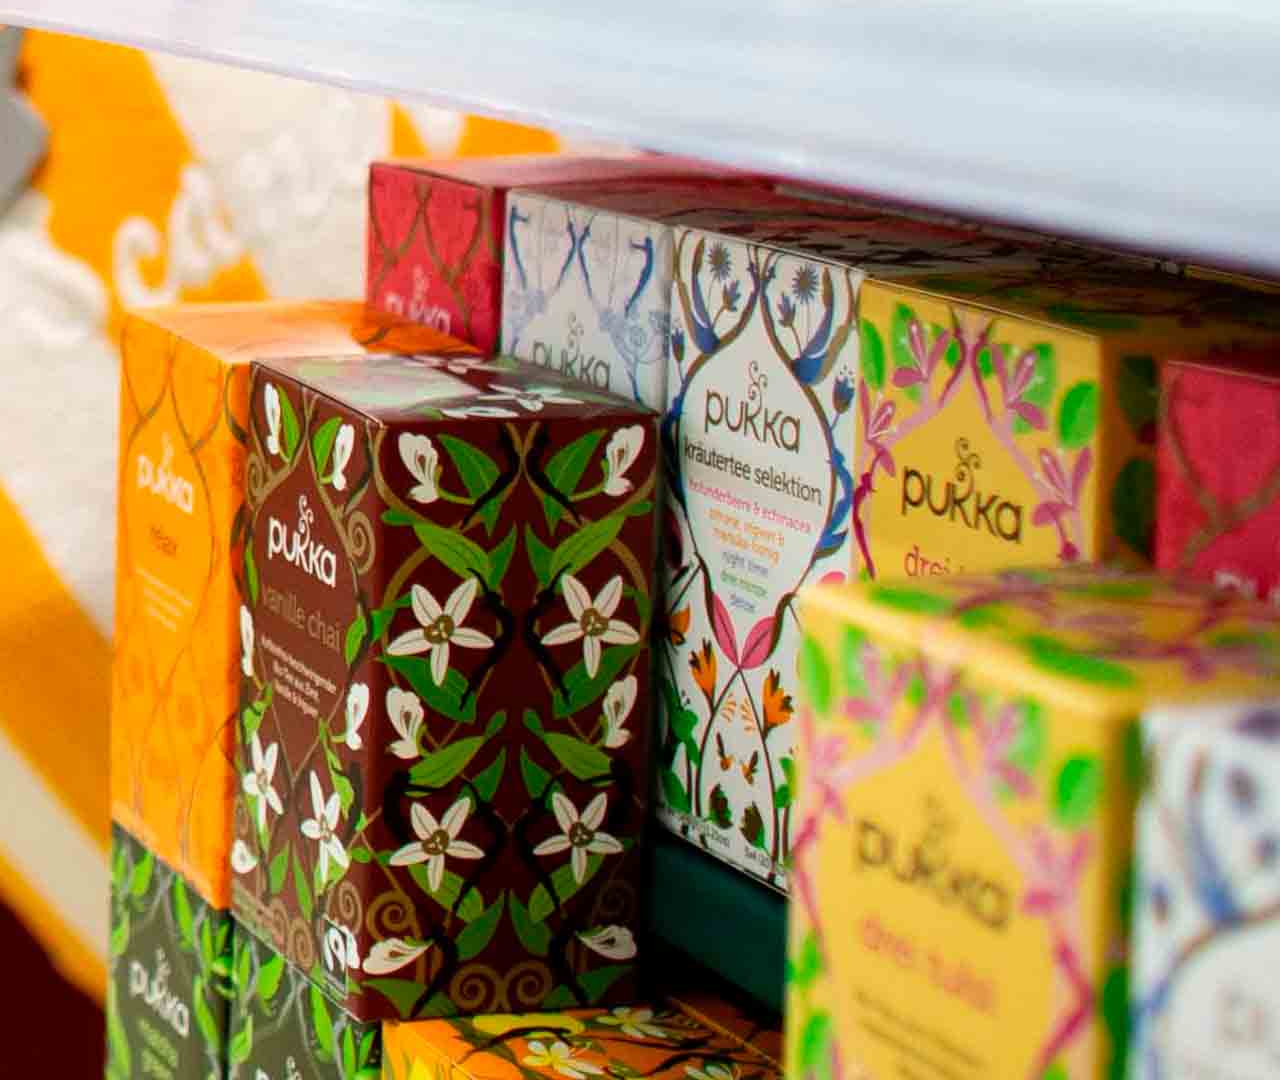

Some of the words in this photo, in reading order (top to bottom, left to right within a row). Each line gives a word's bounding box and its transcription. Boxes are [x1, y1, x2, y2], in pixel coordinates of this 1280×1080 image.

[704, 360, 801, 454] pukka
[136, 432, 193, 514] pukka
[683, 435, 751, 481] kräutertee
[753, 465, 822, 505] selektion
[901, 436, 1022, 544] pukka
[268, 495, 337, 588] pukka
[307, 610, 341, 651] chai
[855, 800, 1012, 934] pukka
[128, 948, 190, 1038] pukka
